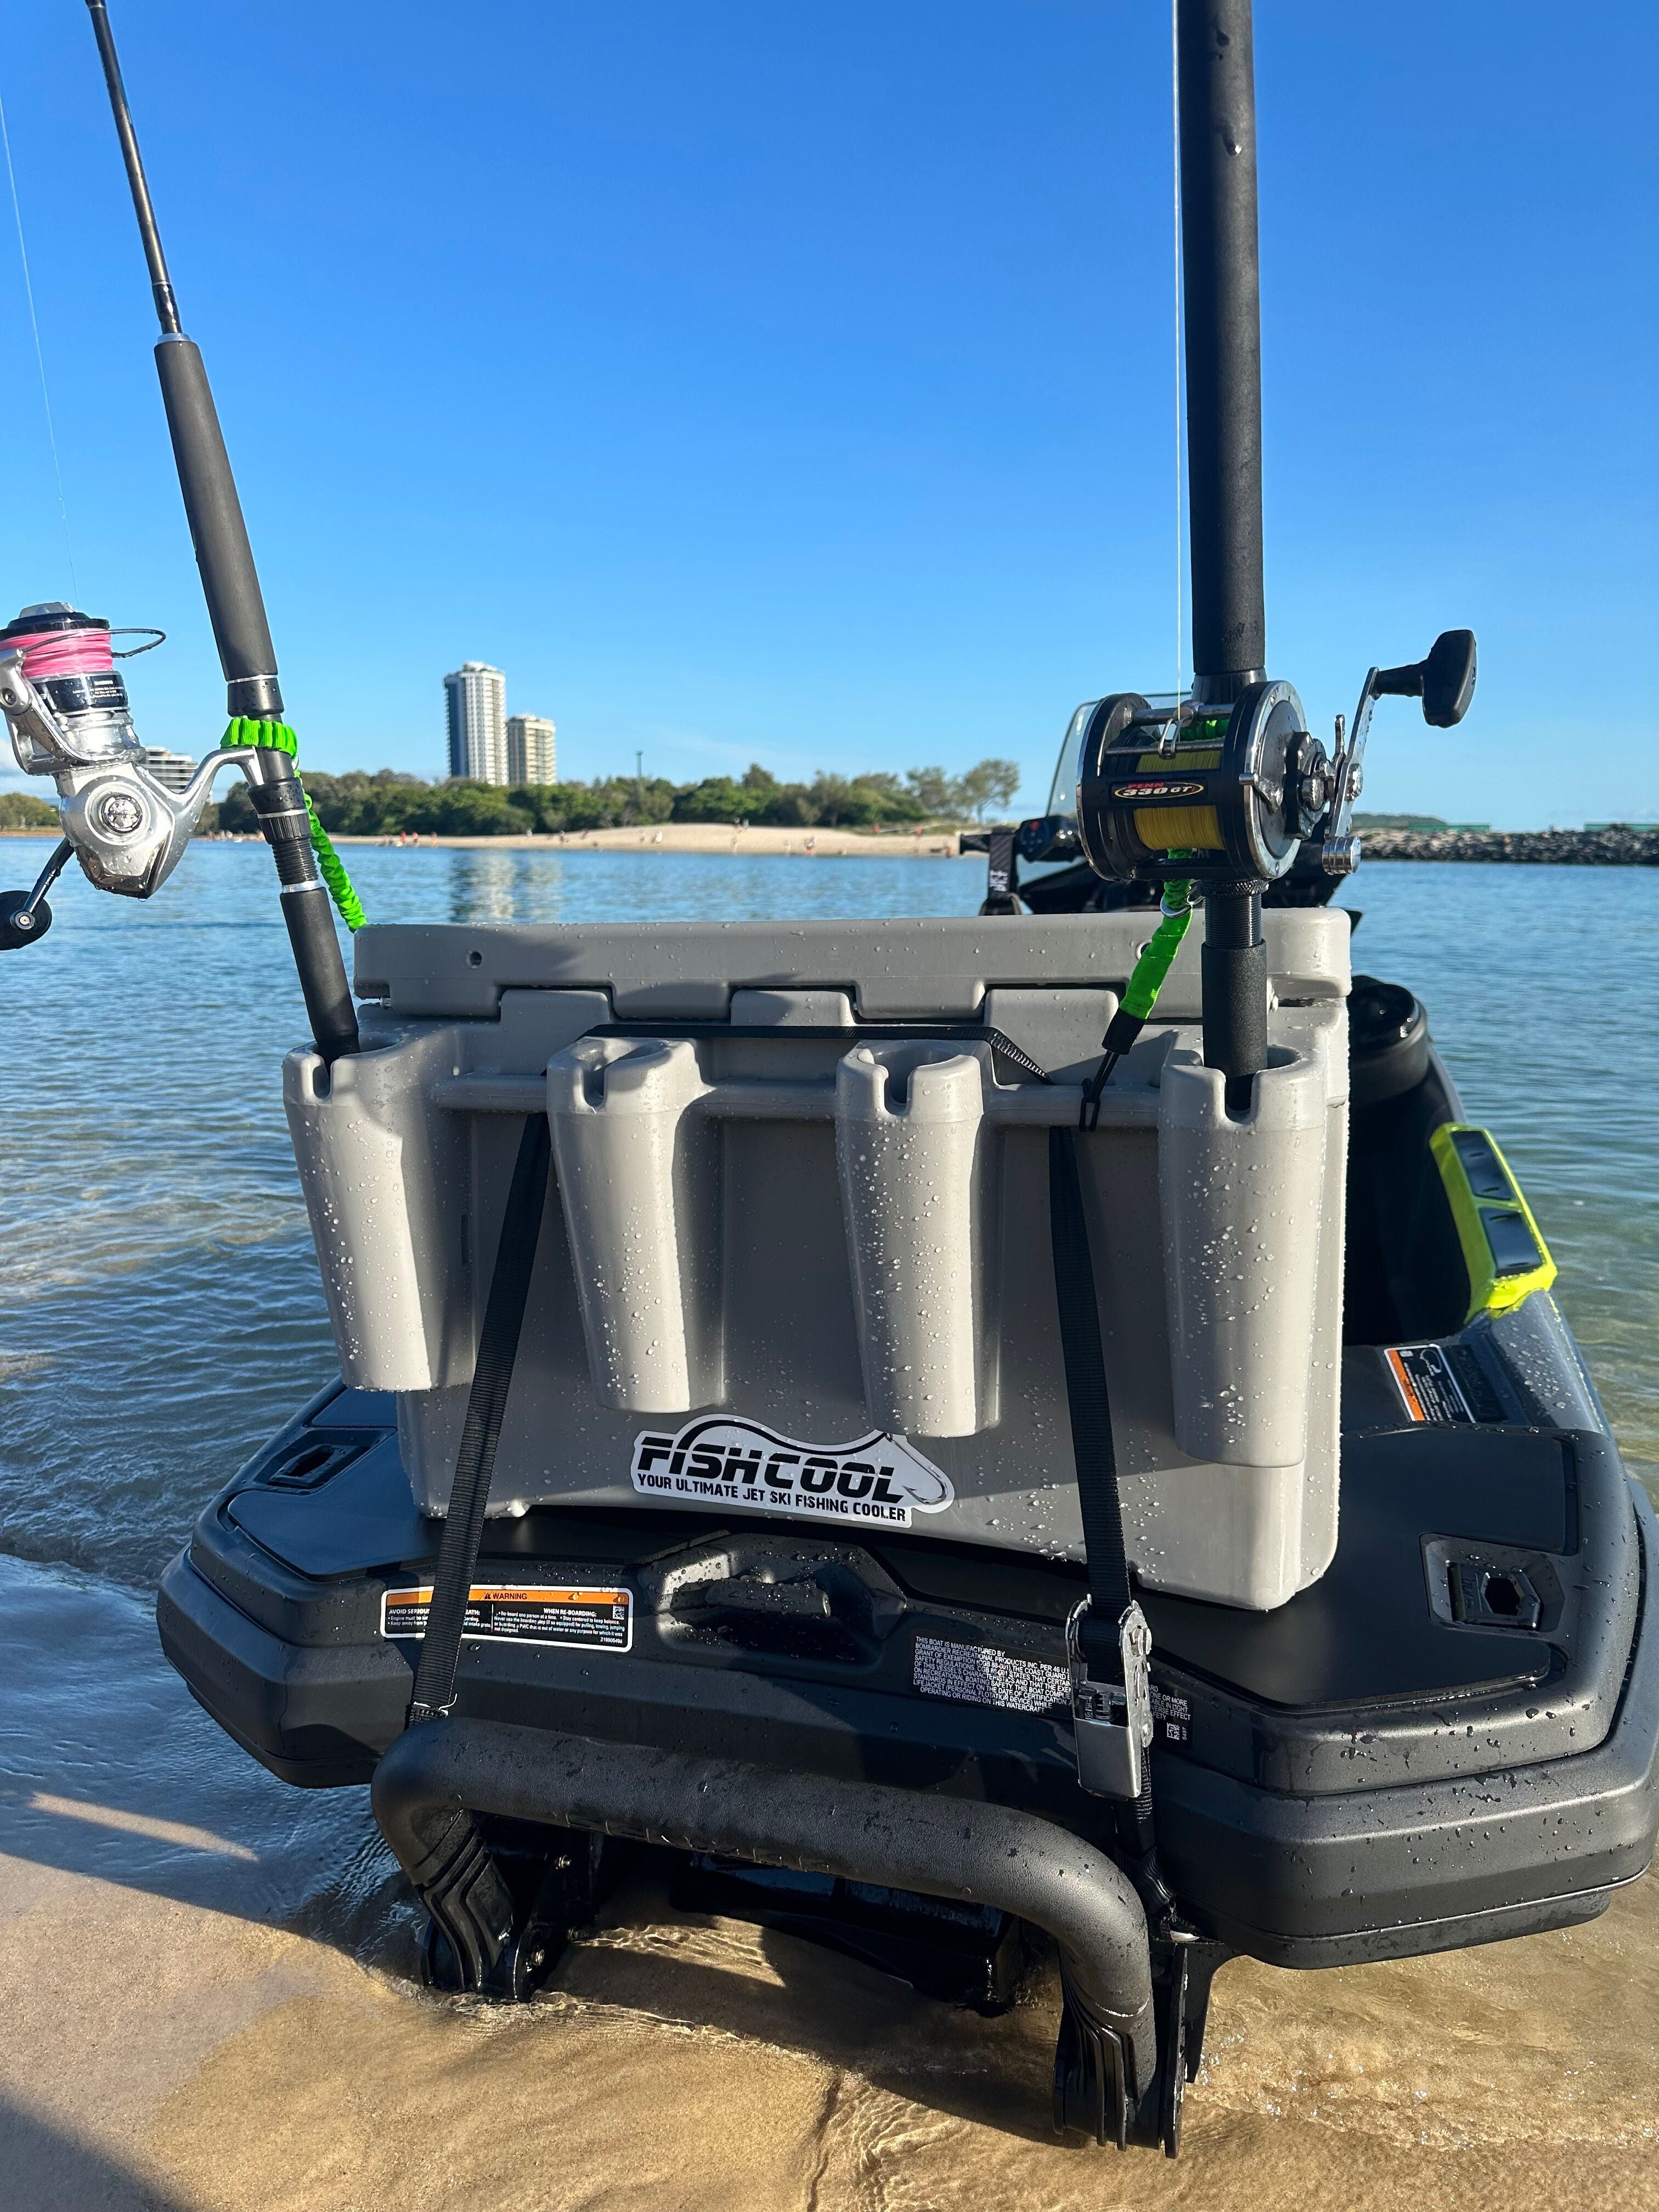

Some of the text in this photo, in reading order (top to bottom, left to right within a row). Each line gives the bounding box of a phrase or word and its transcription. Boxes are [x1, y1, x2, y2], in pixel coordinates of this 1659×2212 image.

[1123, 787, 1169, 796] 330
[637, 1436, 904, 1503] FISHCOOL
[637, 1473, 906, 1521] YOUR ULTIMATE JET SKI FISHING COOLER
[916, 1643, 951, 1654] BOMBARDIER
[952, 1649, 994, 1661] RECREATIONAL
[995, 1656, 1026, 1667] PRODUCTS
[951, 1642, 996, 1655] MANUFACTURED
[914, 1673, 946, 1684] STANDARDS
[954, 1680, 975, 1689] EFFECT
[998, 1688, 1013, 1696] DATE
[915, 1648, 933, 1657] GRANT
[944, 1654, 975, 1664] EXEMPTION
[1025, 1667, 1043, 1676] COAST
[1046, 1671, 1066, 1680] GUARD
[1150, 1691, 1161, 1700] ONE
[1171, 1696, 1188, 1707] MORE
[915, 1655, 935, 1663] SAFETY
[1009, 1671, 1030, 1680] STATES
[1172, 1704, 1188, 1713] LIGHT
[923, 1668, 964, 1681] RECREATIONAL
[966, 1676, 990, 1686] BOATING
[1029, 1687, 1044, 1695] BOAT
[913, 1679, 1052, 1709] LIFEJACKET (PERSONAL FLOTATION DEVICE) WHILE
[921, 1686, 951, 1697] OPERATING
[962, 1694, 981, 1702] RIDING
[936, 1664, 962, 1674] VESSEL'S
[963, 1669, 1015, 1684] CHARACTERISTICS
[1170, 1711, 1191, 1721] EFFECT
